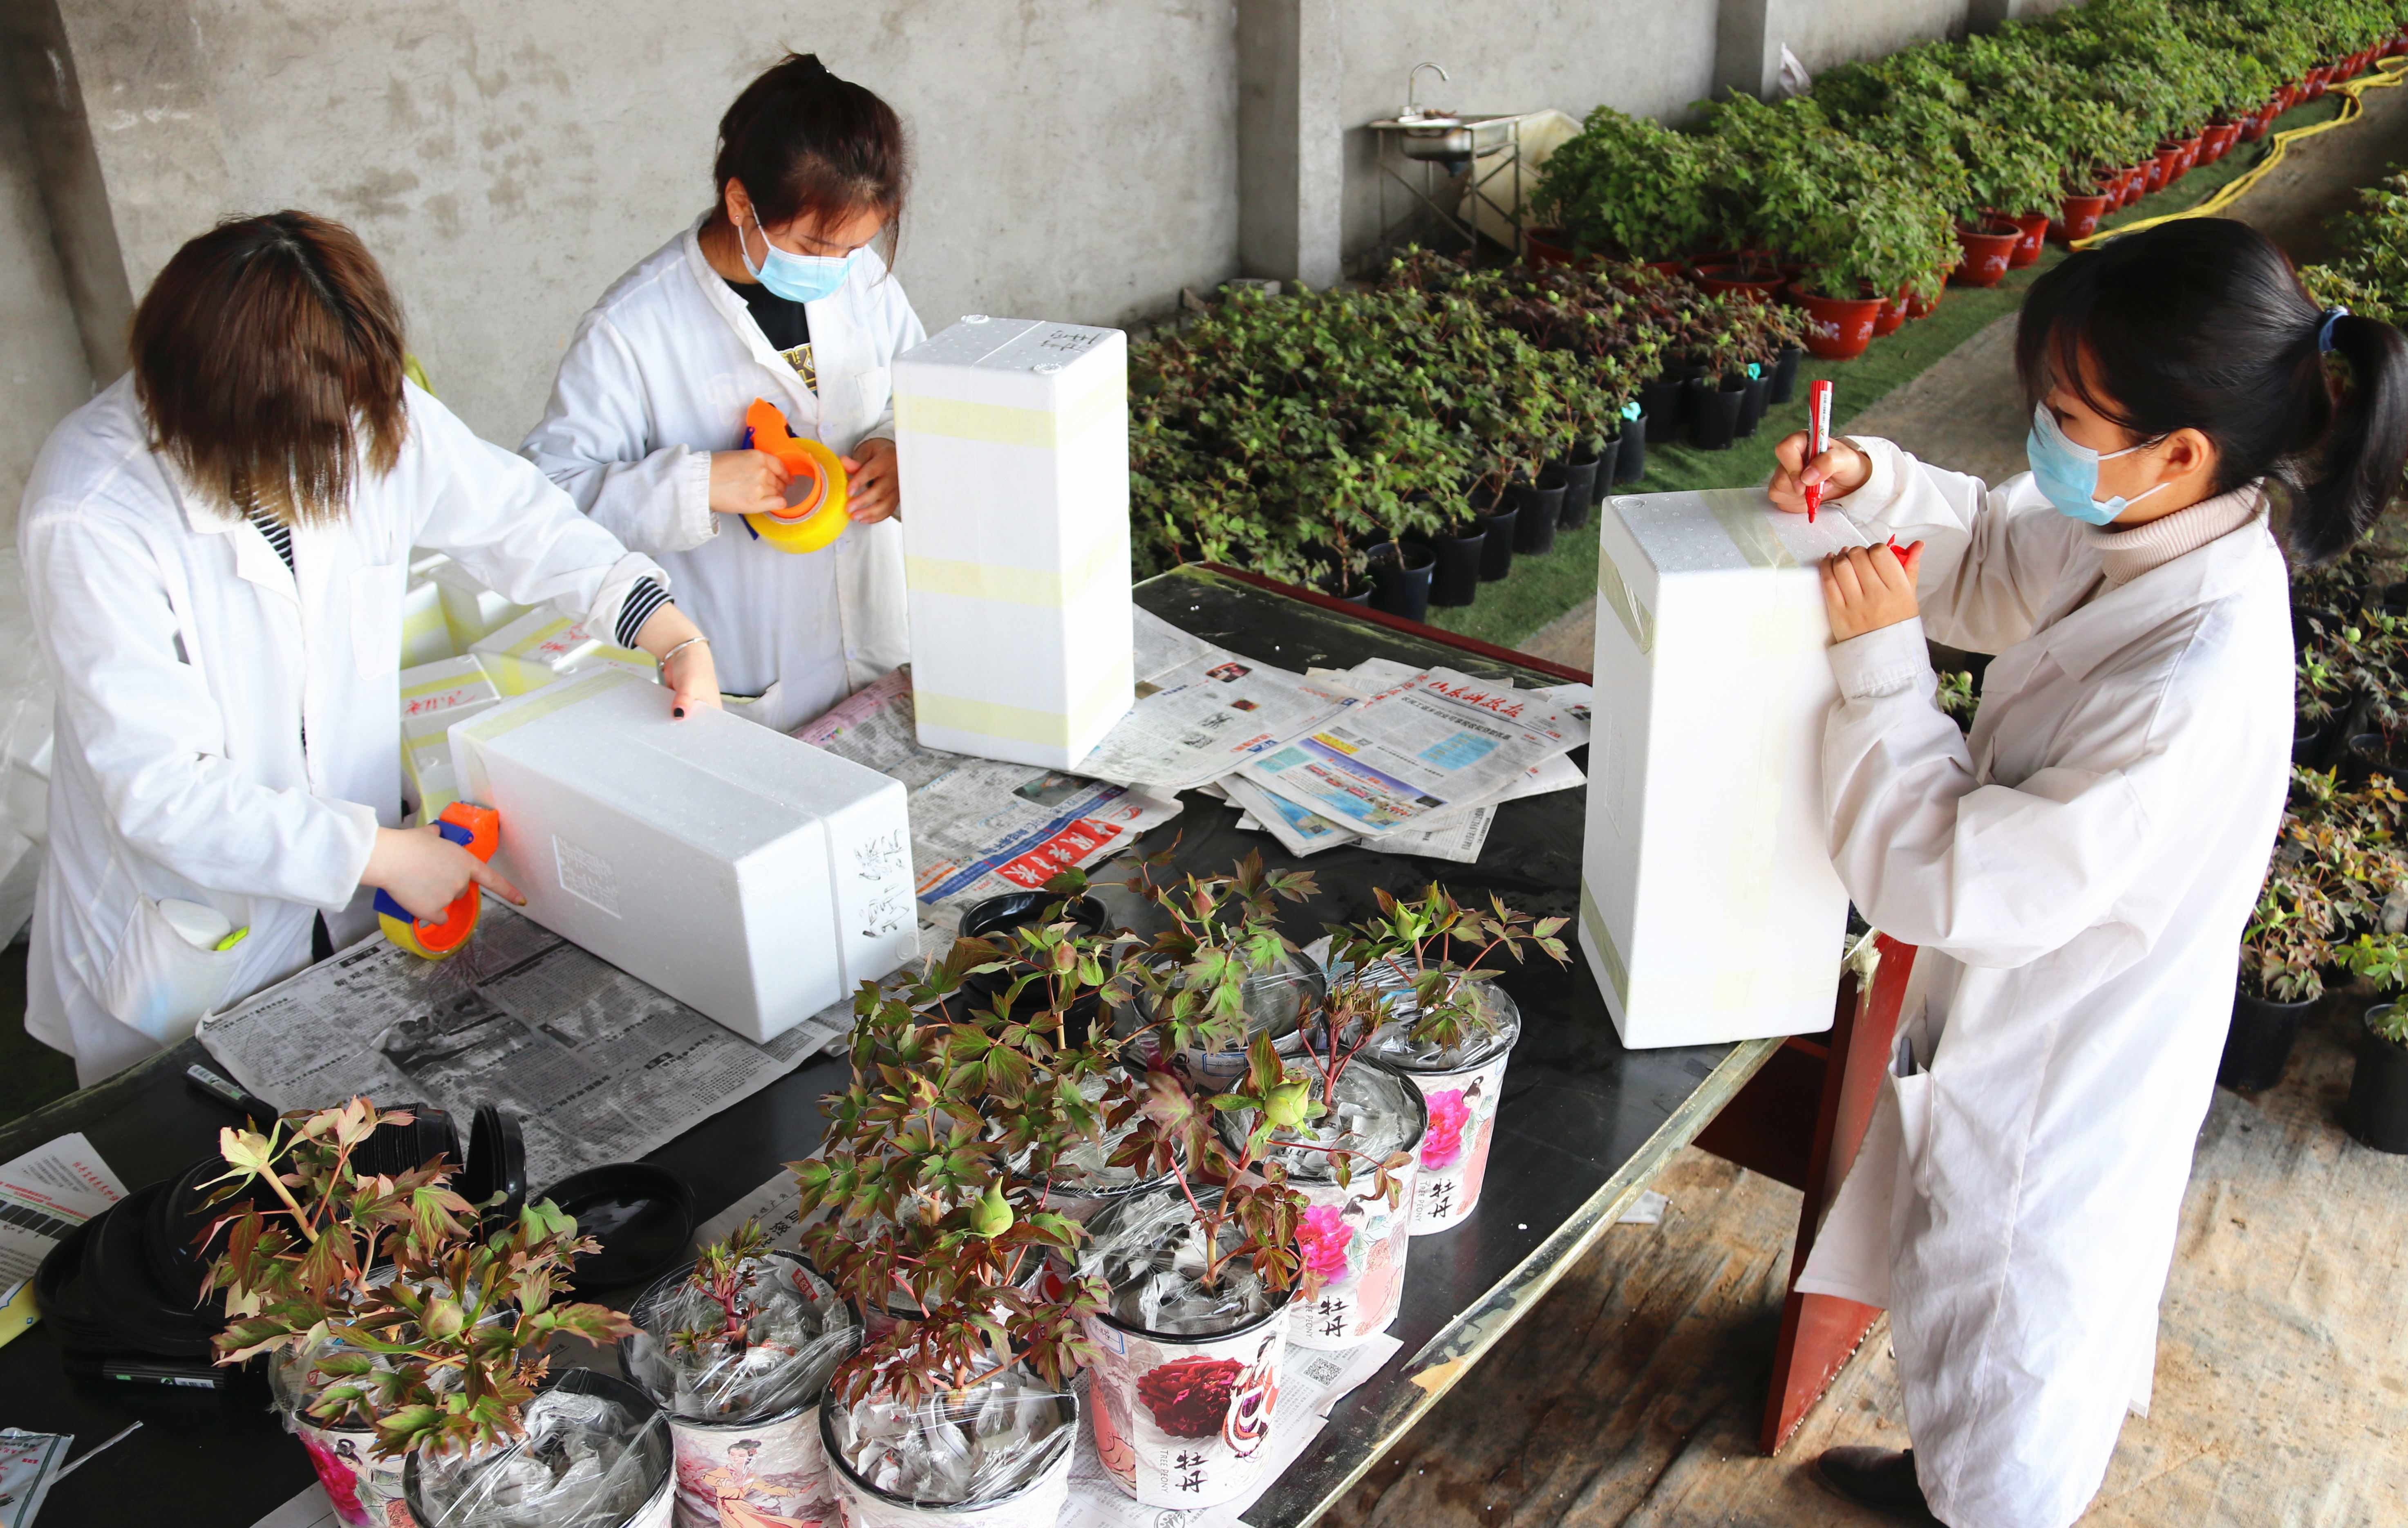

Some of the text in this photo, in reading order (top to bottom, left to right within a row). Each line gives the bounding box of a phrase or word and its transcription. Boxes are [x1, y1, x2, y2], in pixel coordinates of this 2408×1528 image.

[1428, 681, 1524, 718] 山东科技报
[1415, 1181, 1427, 1222] TREE PEONY
[1428, 1178, 1457, 1218] 牡丹
[1318, 1296, 1349, 1337] 牡丹
[1160, 1450, 1169, 1493] TREE PEONY
[1174, 1450, 1209, 1493] 牡丹
